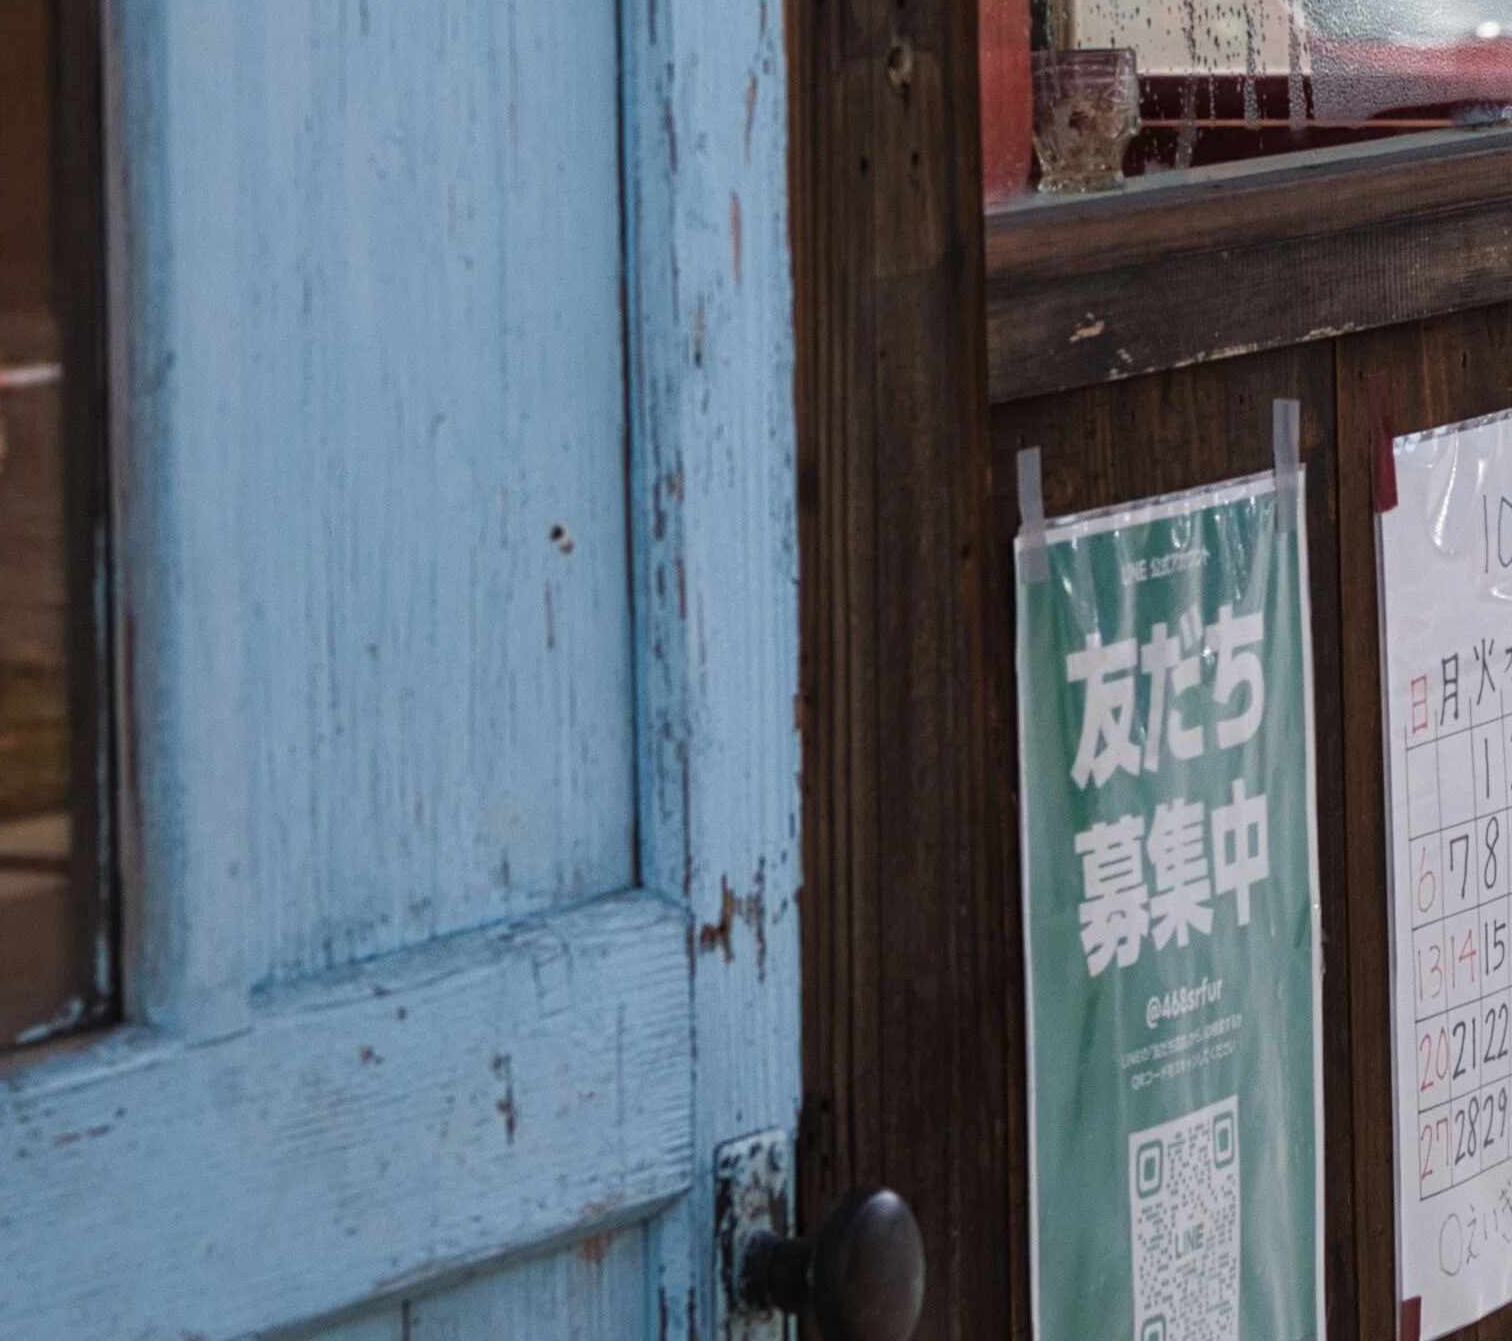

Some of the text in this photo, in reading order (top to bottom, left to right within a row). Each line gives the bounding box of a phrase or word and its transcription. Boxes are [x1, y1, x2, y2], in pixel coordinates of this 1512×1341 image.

[1066, 604, 1266, 793] 友だち
[1410, 674, 1428, 734] 日
[1440, 652, 1459, 726] 月
[1473, 637, 1495, 705] 火
[1484, 738, 1490, 799] 1
[1074, 779, 1271, 978] 募集中
[1418, 846, 1436, 913] 6
[1449, 834, 1469, 899] 7
[1484, 816, 1499, 889] 8
[1145, 976, 1224, 1030] @468srfur
[1417, 945, 1443, 1001] 13
[1451, 928, 1477, 989] 14
[1484, 919, 1506, 976] 15
[1419, 1026, 1450, 1093] 20
[1452, 1017, 1476, 1081] 21
[1483, 1002, 1509, 1063] 22
[1420, 1117, 1450, 1181] 27
[1454, 1096, 1479, 1166] 28
[1483, 1087, 1507, 1149] 29
[1175, 1221, 1205, 1260] LINE
